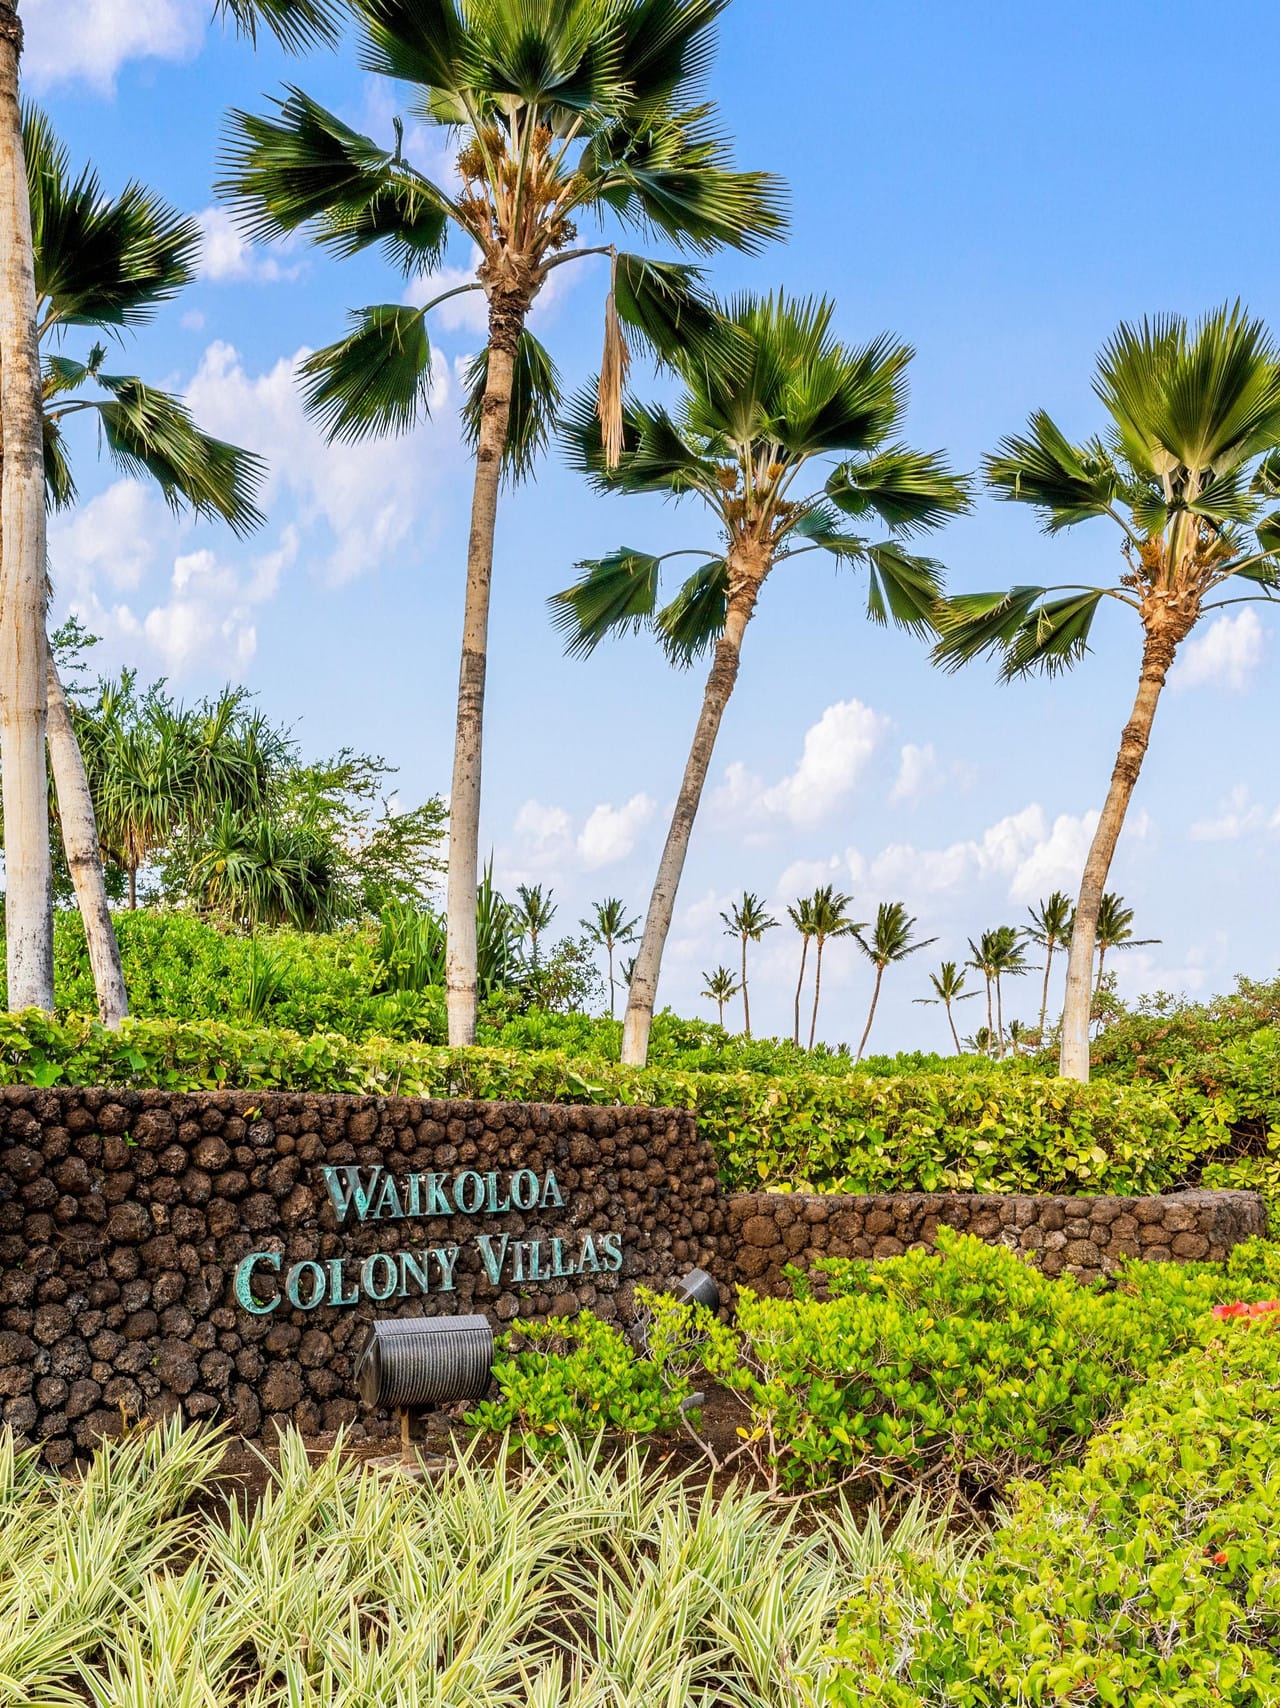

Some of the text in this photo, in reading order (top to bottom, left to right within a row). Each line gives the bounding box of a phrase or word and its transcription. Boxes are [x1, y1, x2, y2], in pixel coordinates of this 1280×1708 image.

[322, 1165, 565, 1222] WAIKOLOA
[234, 1232, 623, 1315] COLONY VILLAS
